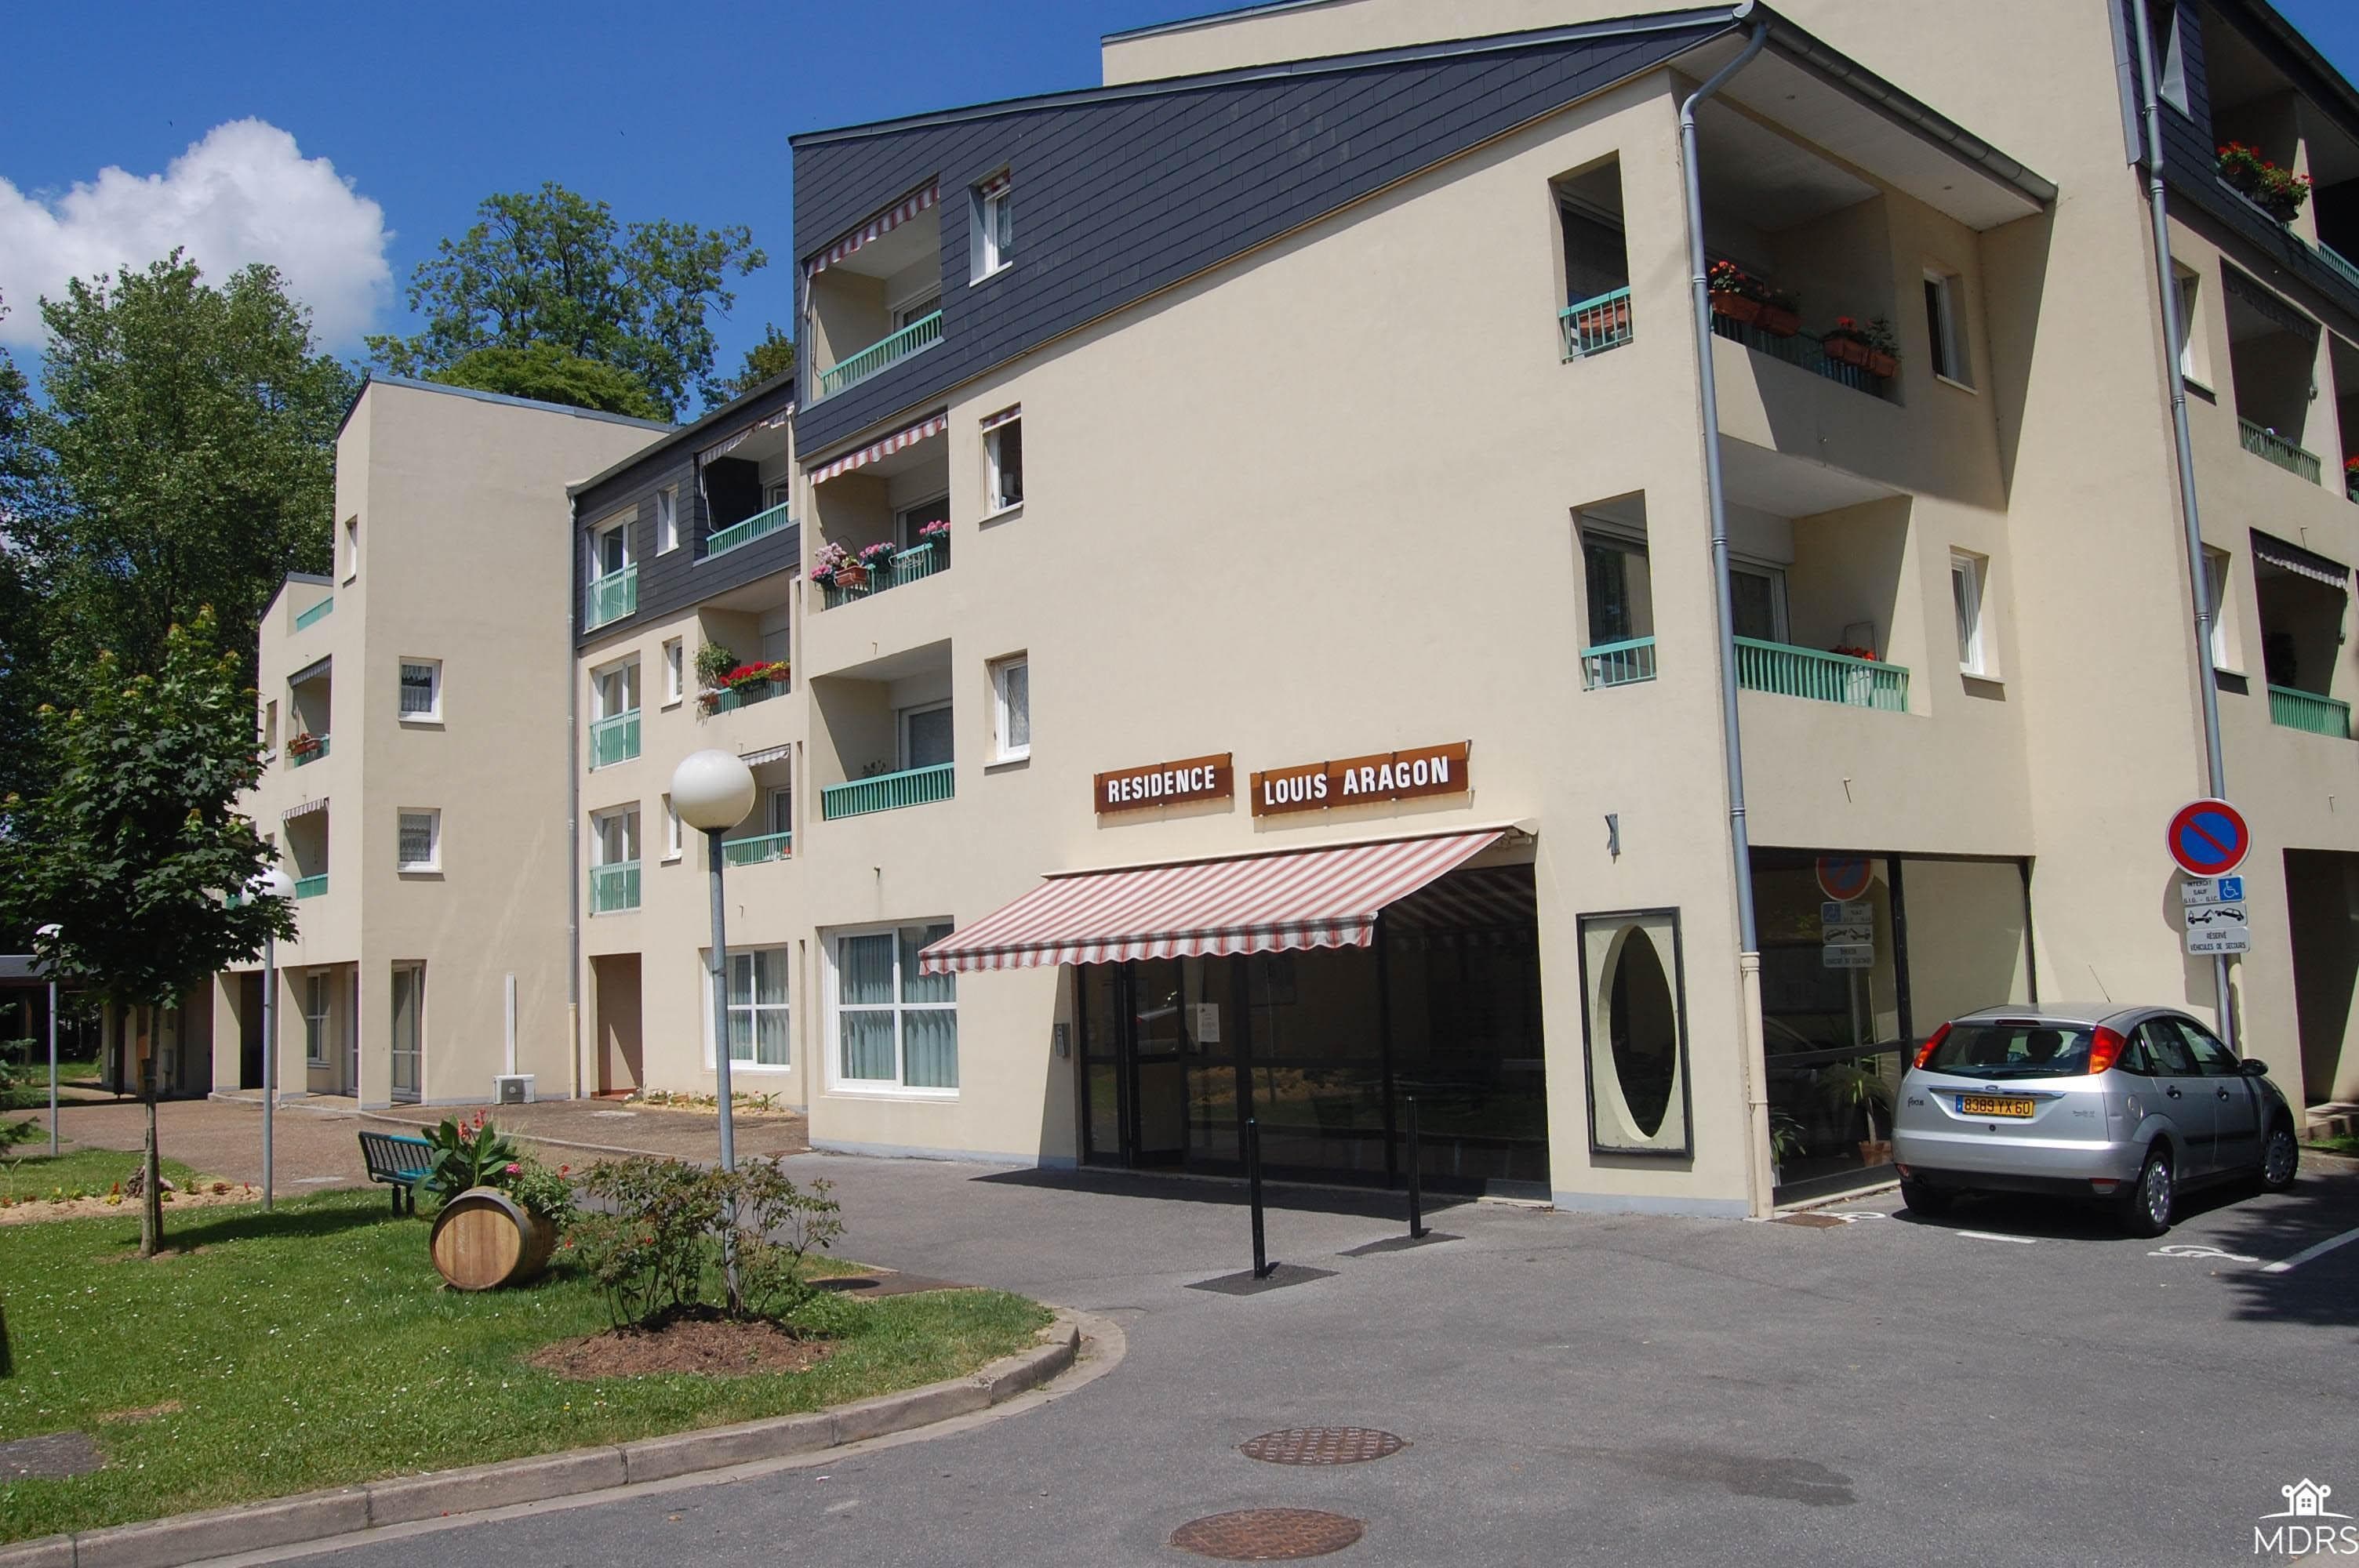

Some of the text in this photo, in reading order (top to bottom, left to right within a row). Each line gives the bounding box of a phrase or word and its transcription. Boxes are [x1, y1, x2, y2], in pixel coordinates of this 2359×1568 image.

[1108, 764, 1215, 803] RESIDENCE
[1265, 756, 1448, 805] LOUIS ARAGON
[1965, 1098, 2030, 1114] 8389 YX 60
